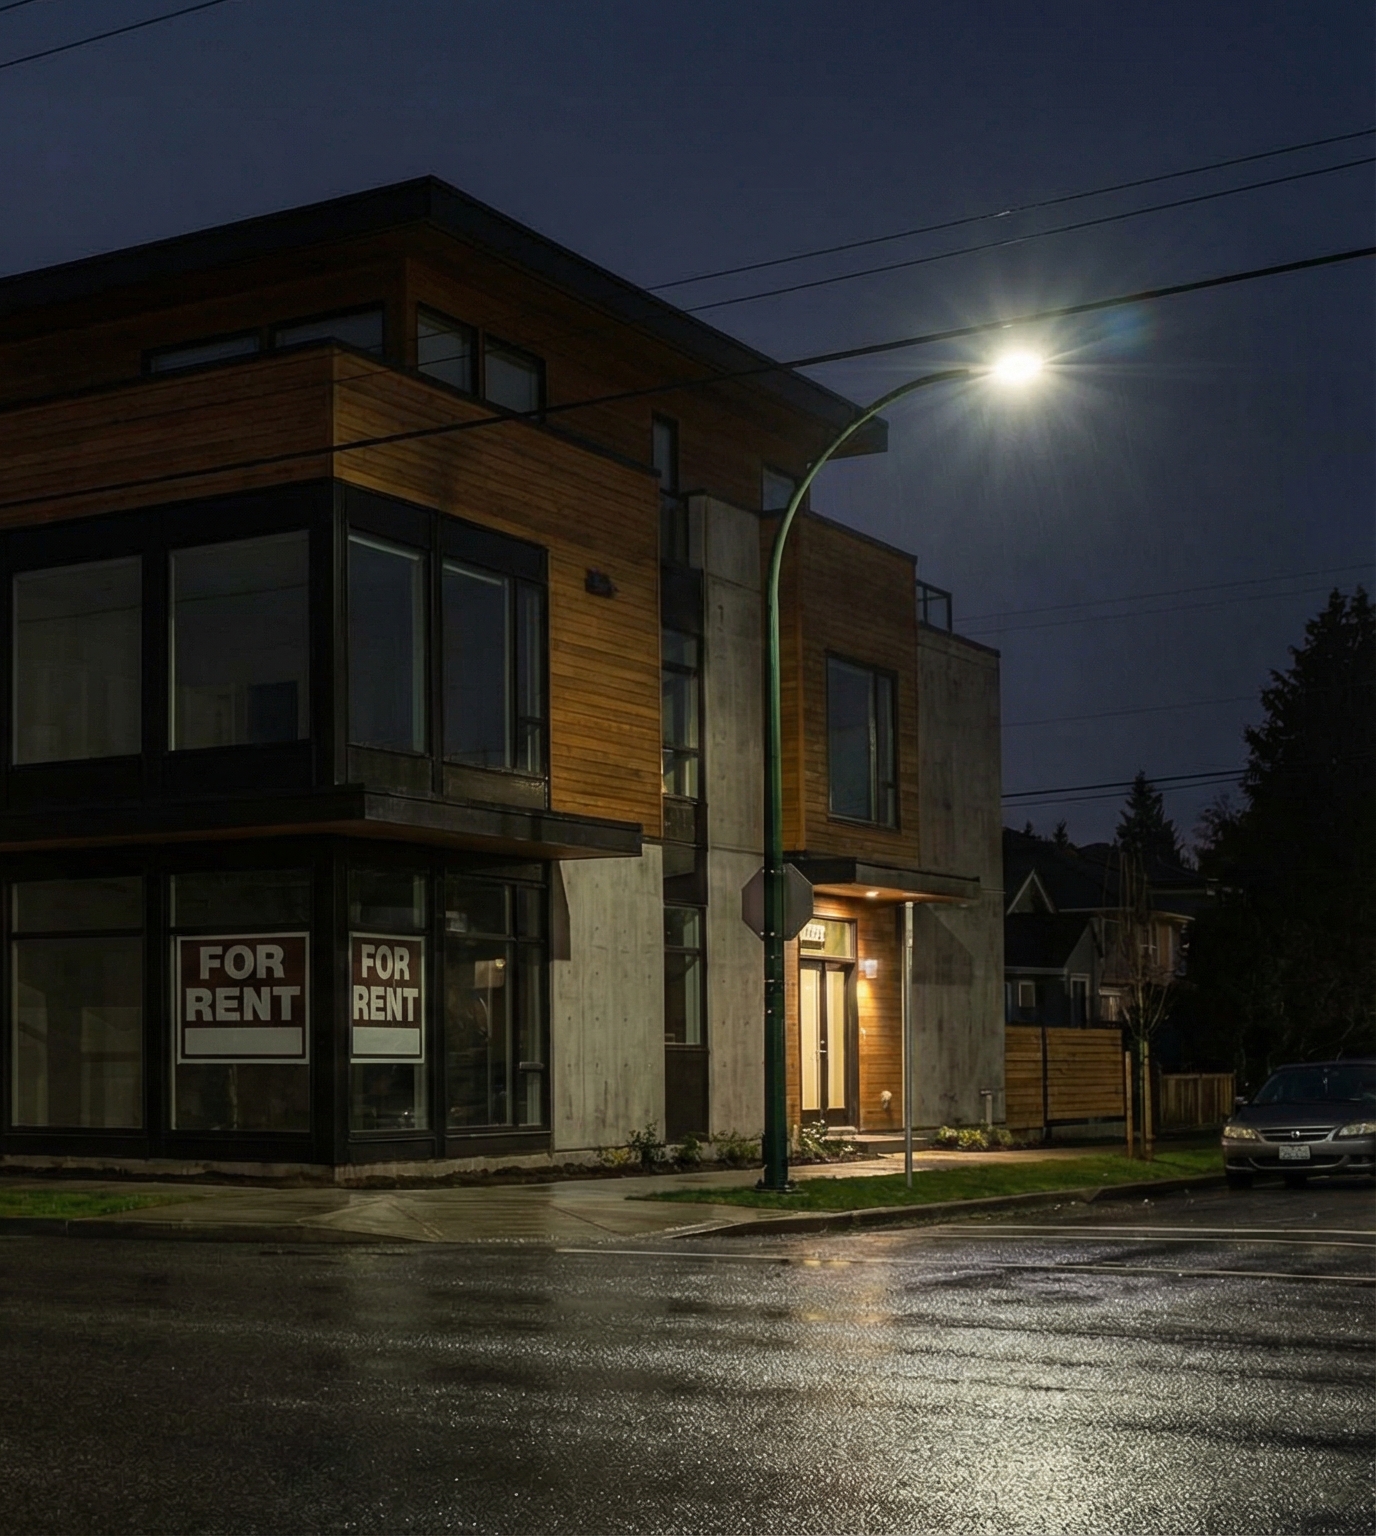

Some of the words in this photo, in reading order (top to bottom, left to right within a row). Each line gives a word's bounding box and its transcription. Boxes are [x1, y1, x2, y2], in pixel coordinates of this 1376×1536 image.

[199, 945, 285, 980] FOR
[361, 944, 410, 980] FOR
[186, 986, 301, 1021] RENT
[353, 985, 419, 1021] RENT
